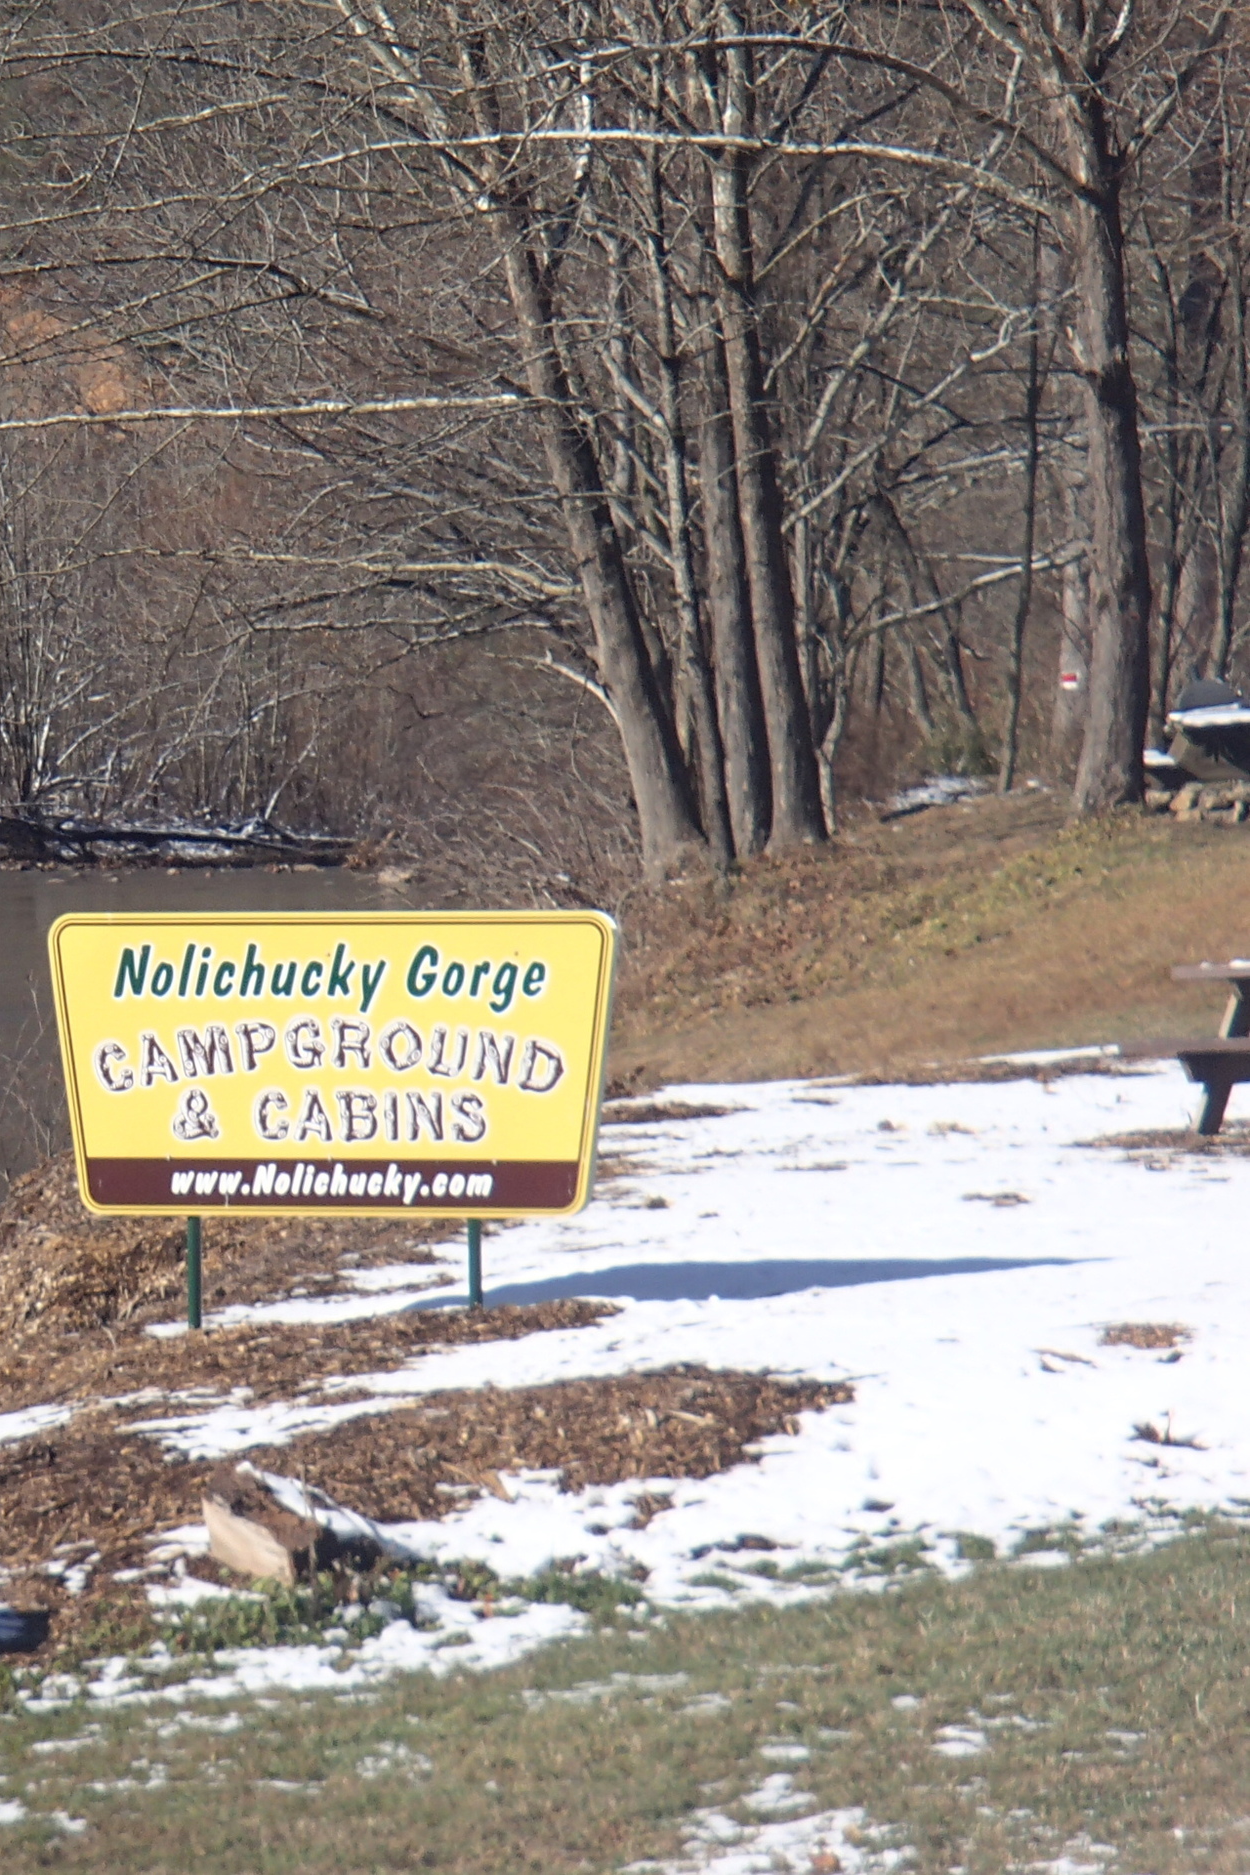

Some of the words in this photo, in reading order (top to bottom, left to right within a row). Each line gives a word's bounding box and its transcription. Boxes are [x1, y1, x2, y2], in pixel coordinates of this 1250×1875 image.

[113, 943, 386, 1013] Nolichucky
[406, 945, 546, 1013] Gorge
[95, 1019, 564, 1092] CAMPGROUND
[172, 1090, 220, 1140] &
[255, 1090, 487, 1142] CABINS
[171, 1164, 493, 1204] www.Nolichucky.com
